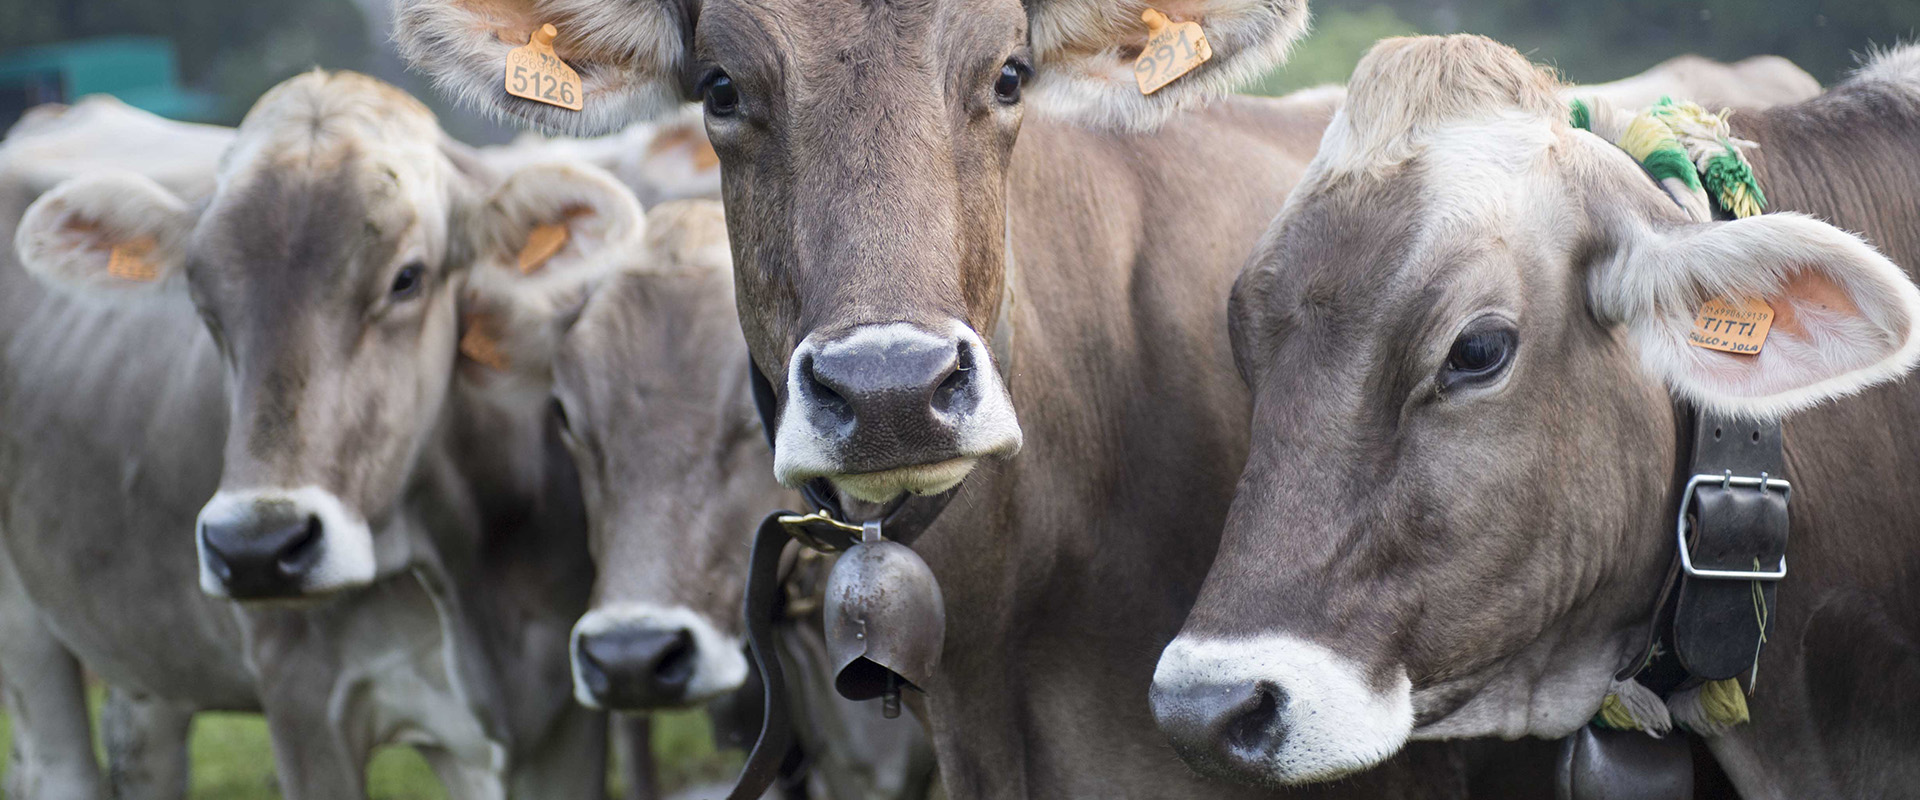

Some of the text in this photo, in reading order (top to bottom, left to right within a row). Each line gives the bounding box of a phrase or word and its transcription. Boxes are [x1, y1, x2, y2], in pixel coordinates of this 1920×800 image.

[1135, 29, 1197, 85] 991
[513, 65, 574, 105] 5126
[1703, 317, 1756, 337] TITTI
